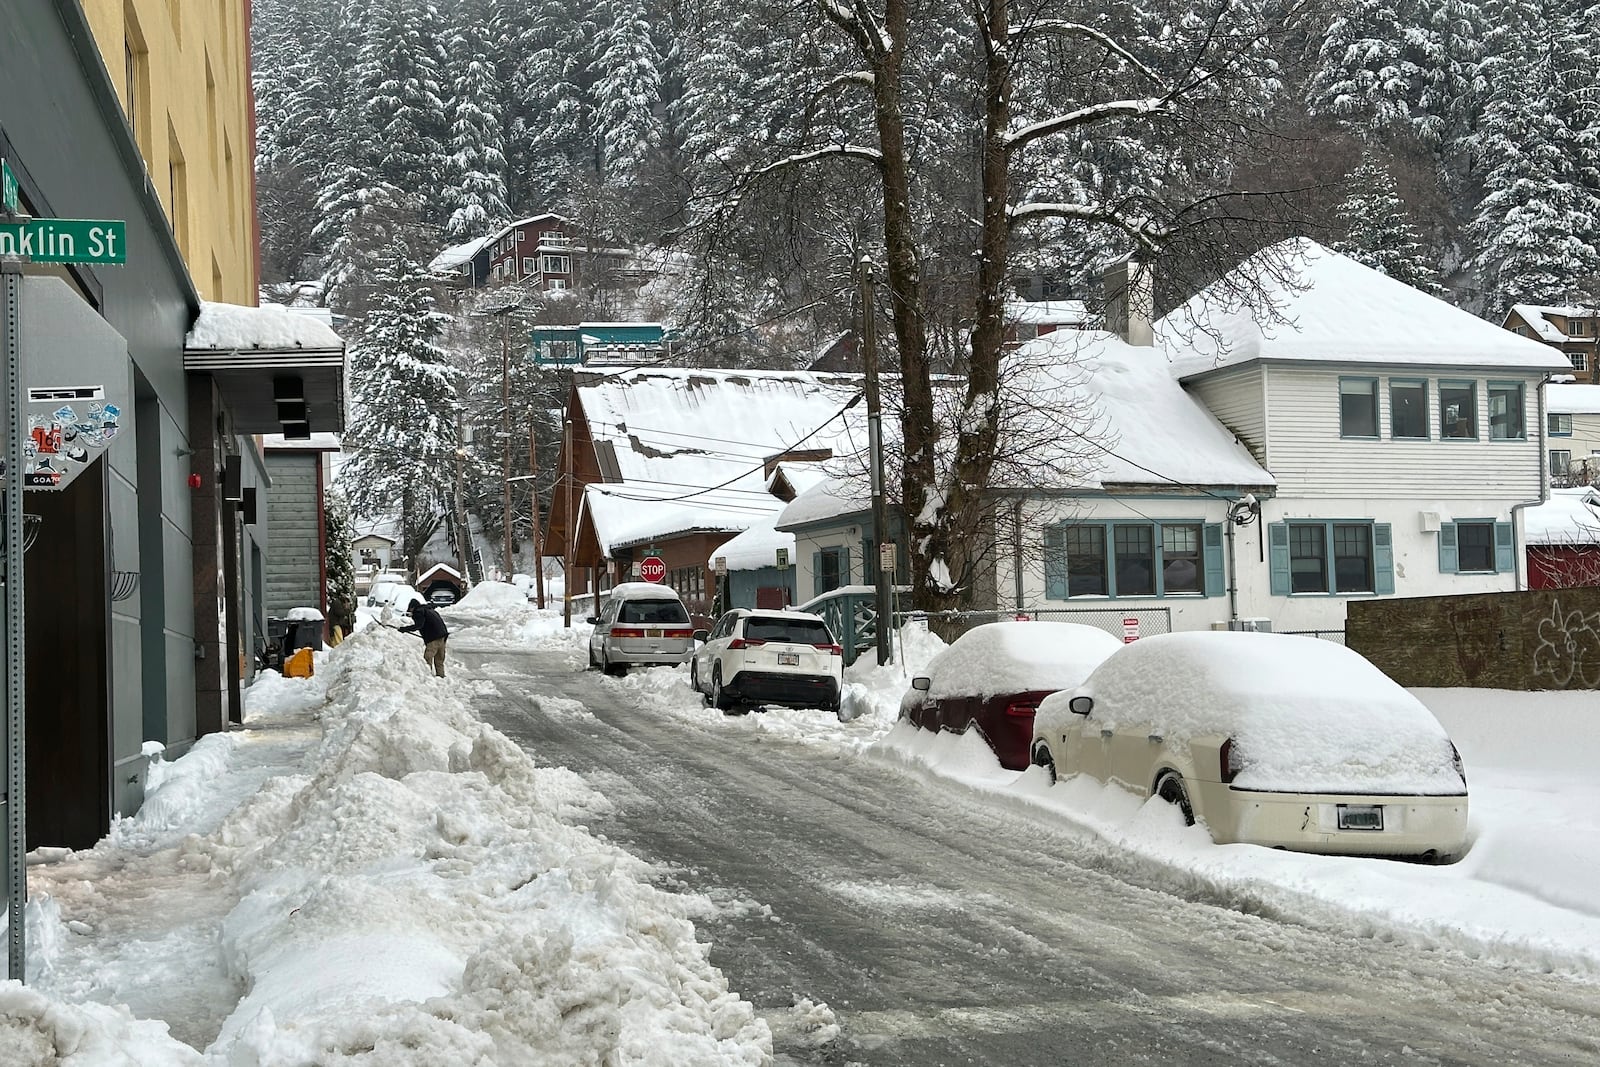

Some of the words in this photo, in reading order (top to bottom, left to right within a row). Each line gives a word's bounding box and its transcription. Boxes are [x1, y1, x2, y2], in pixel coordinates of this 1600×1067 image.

[0, 226, 74, 256] nklin
[88, 227, 116, 257] St
[642, 564, 664, 575] STOP
